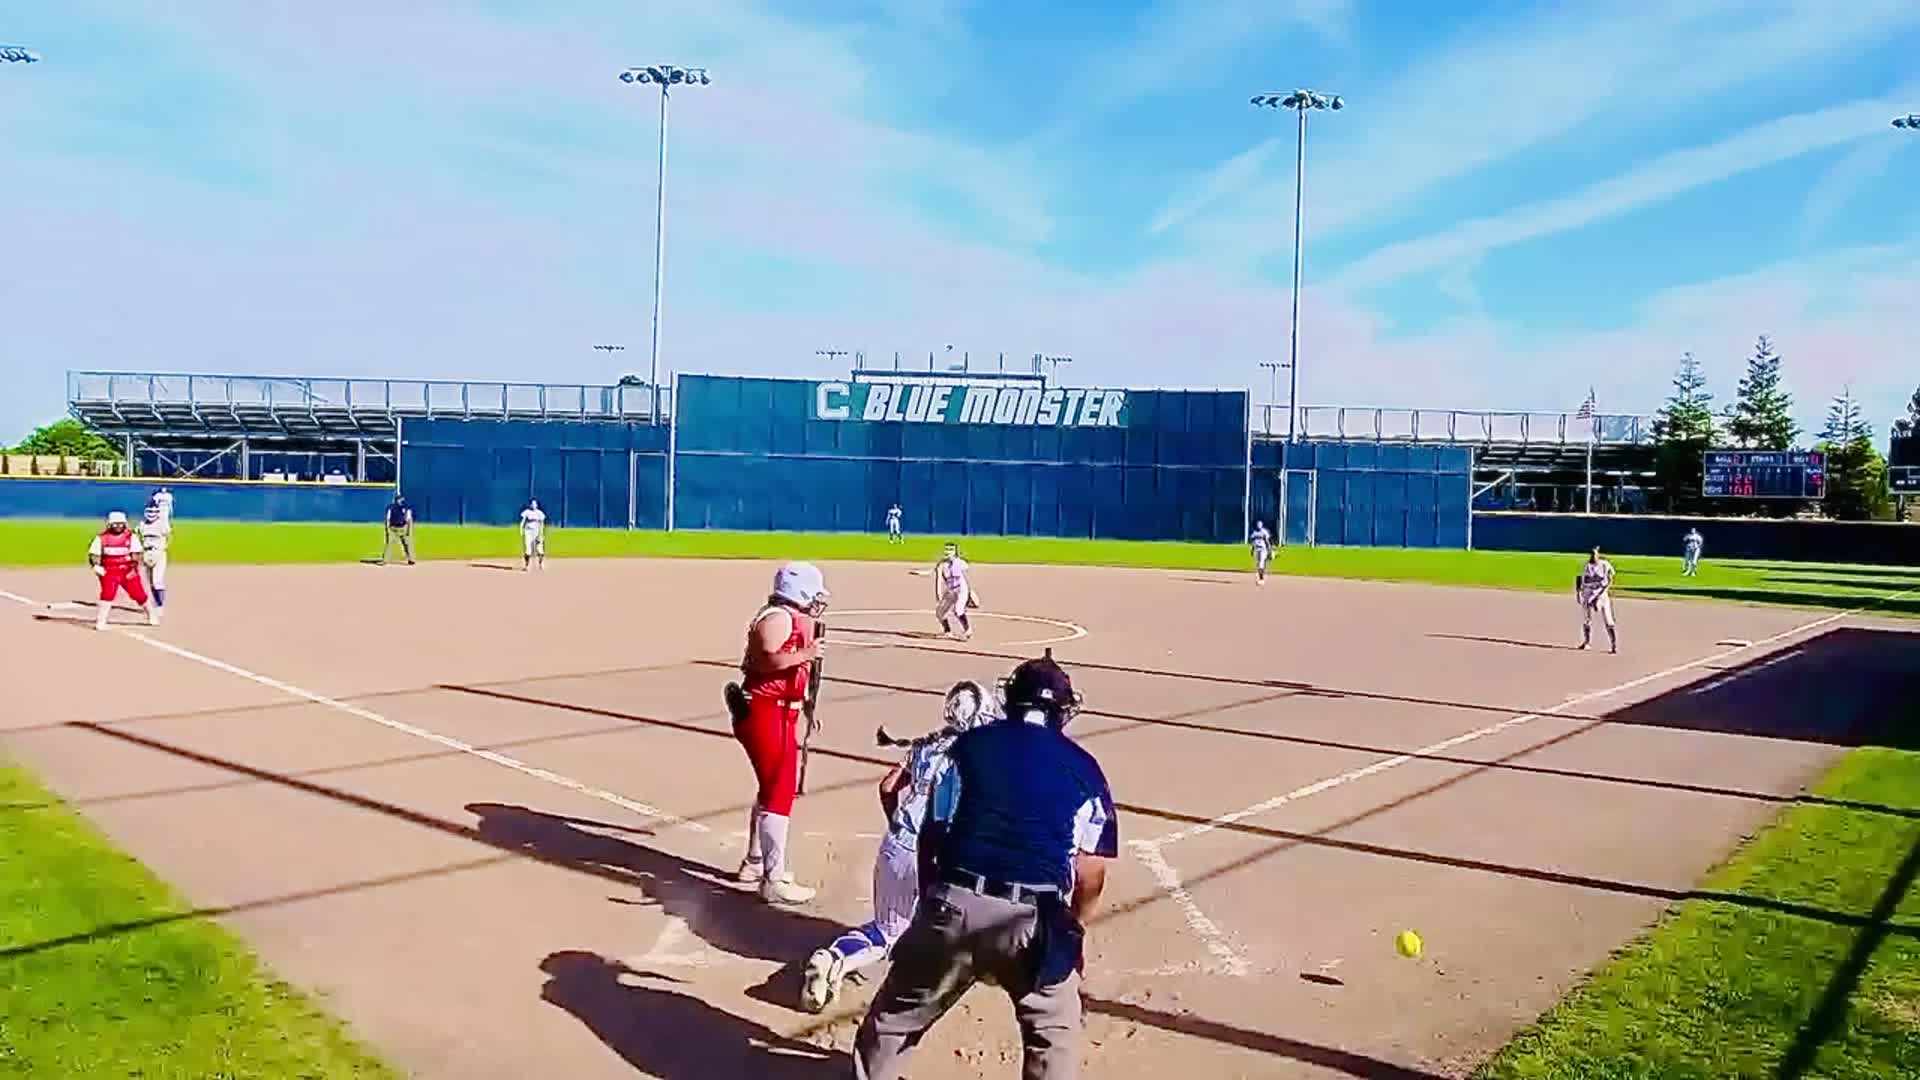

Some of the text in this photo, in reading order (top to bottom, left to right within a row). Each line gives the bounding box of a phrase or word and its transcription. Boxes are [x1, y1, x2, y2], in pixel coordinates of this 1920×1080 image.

[817, 382, 1126, 426] C BLUE MONSTER
